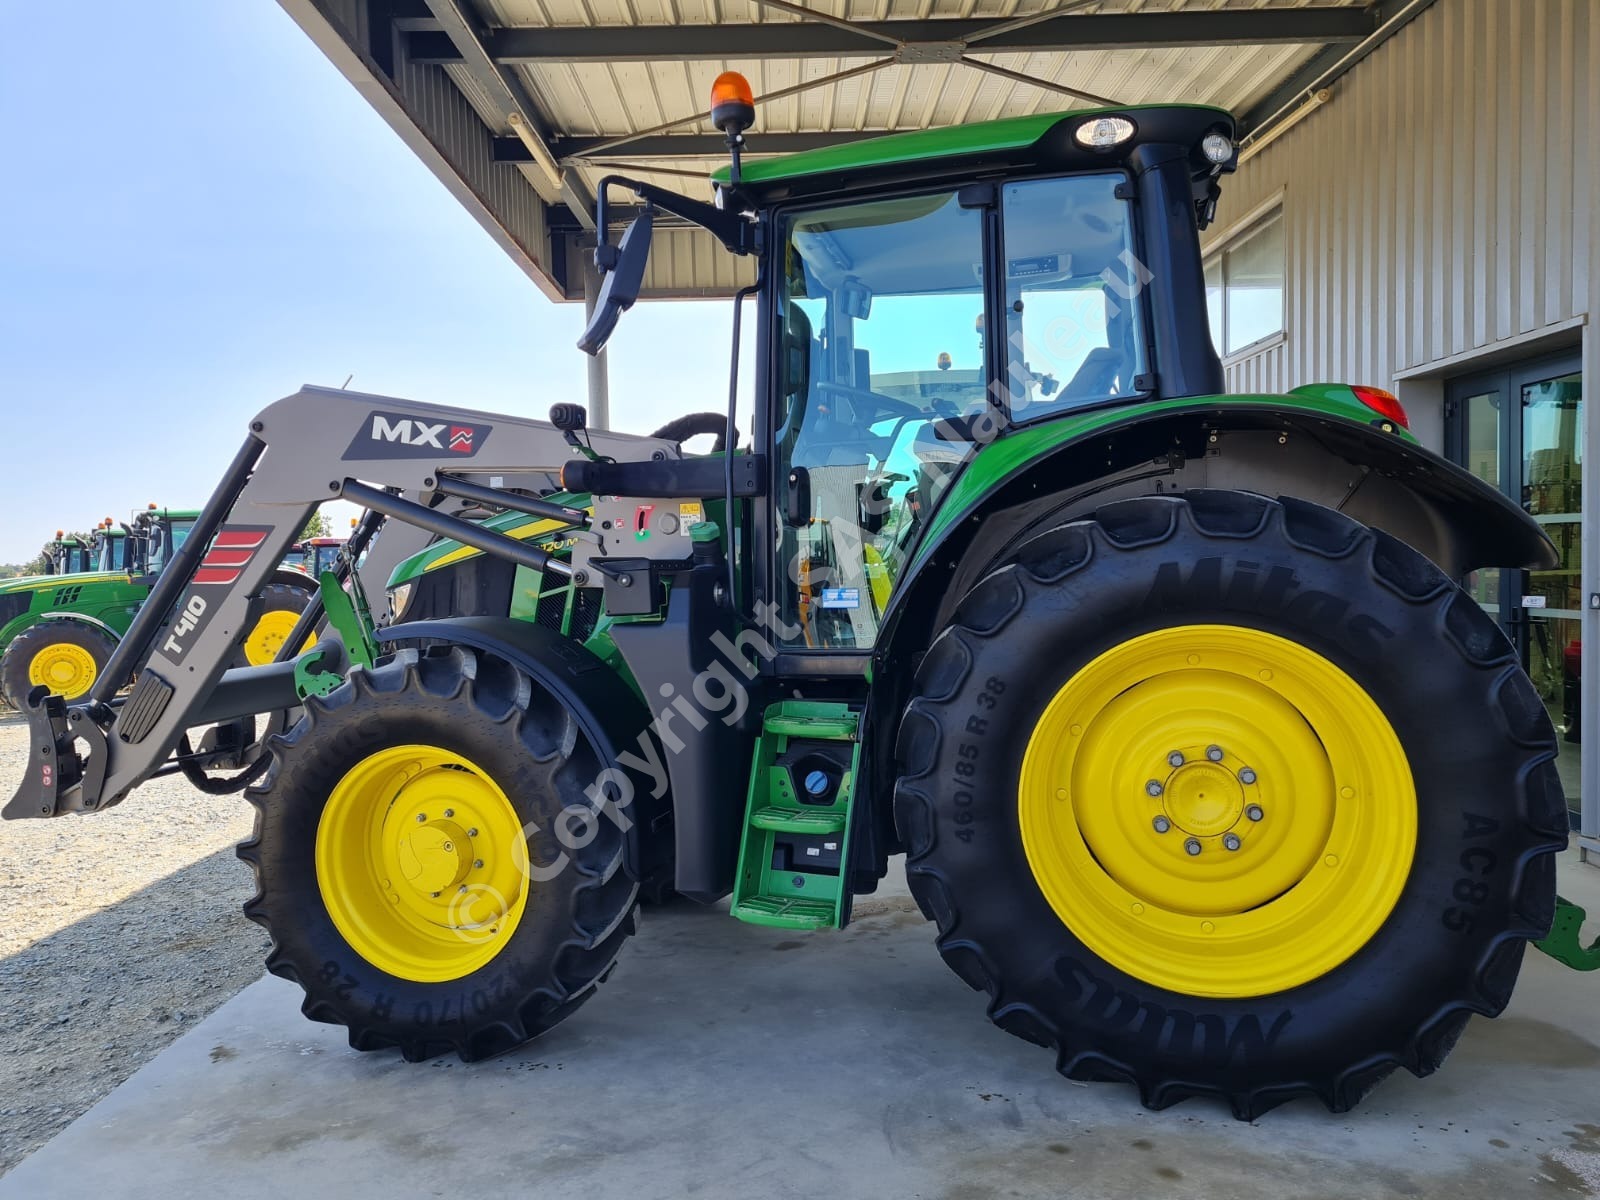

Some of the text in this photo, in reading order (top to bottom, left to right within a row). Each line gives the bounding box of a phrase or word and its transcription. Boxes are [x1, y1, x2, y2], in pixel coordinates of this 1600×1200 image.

[371, 415, 447, 449] MX
[163, 595, 207, 654] T410
[1143, 556, 1395, 663] Mitas
[953, 675, 1006, 843] 460/85 R 38
[1441, 811, 1500, 935] AC85
[320, 960, 359, 1001] 28
